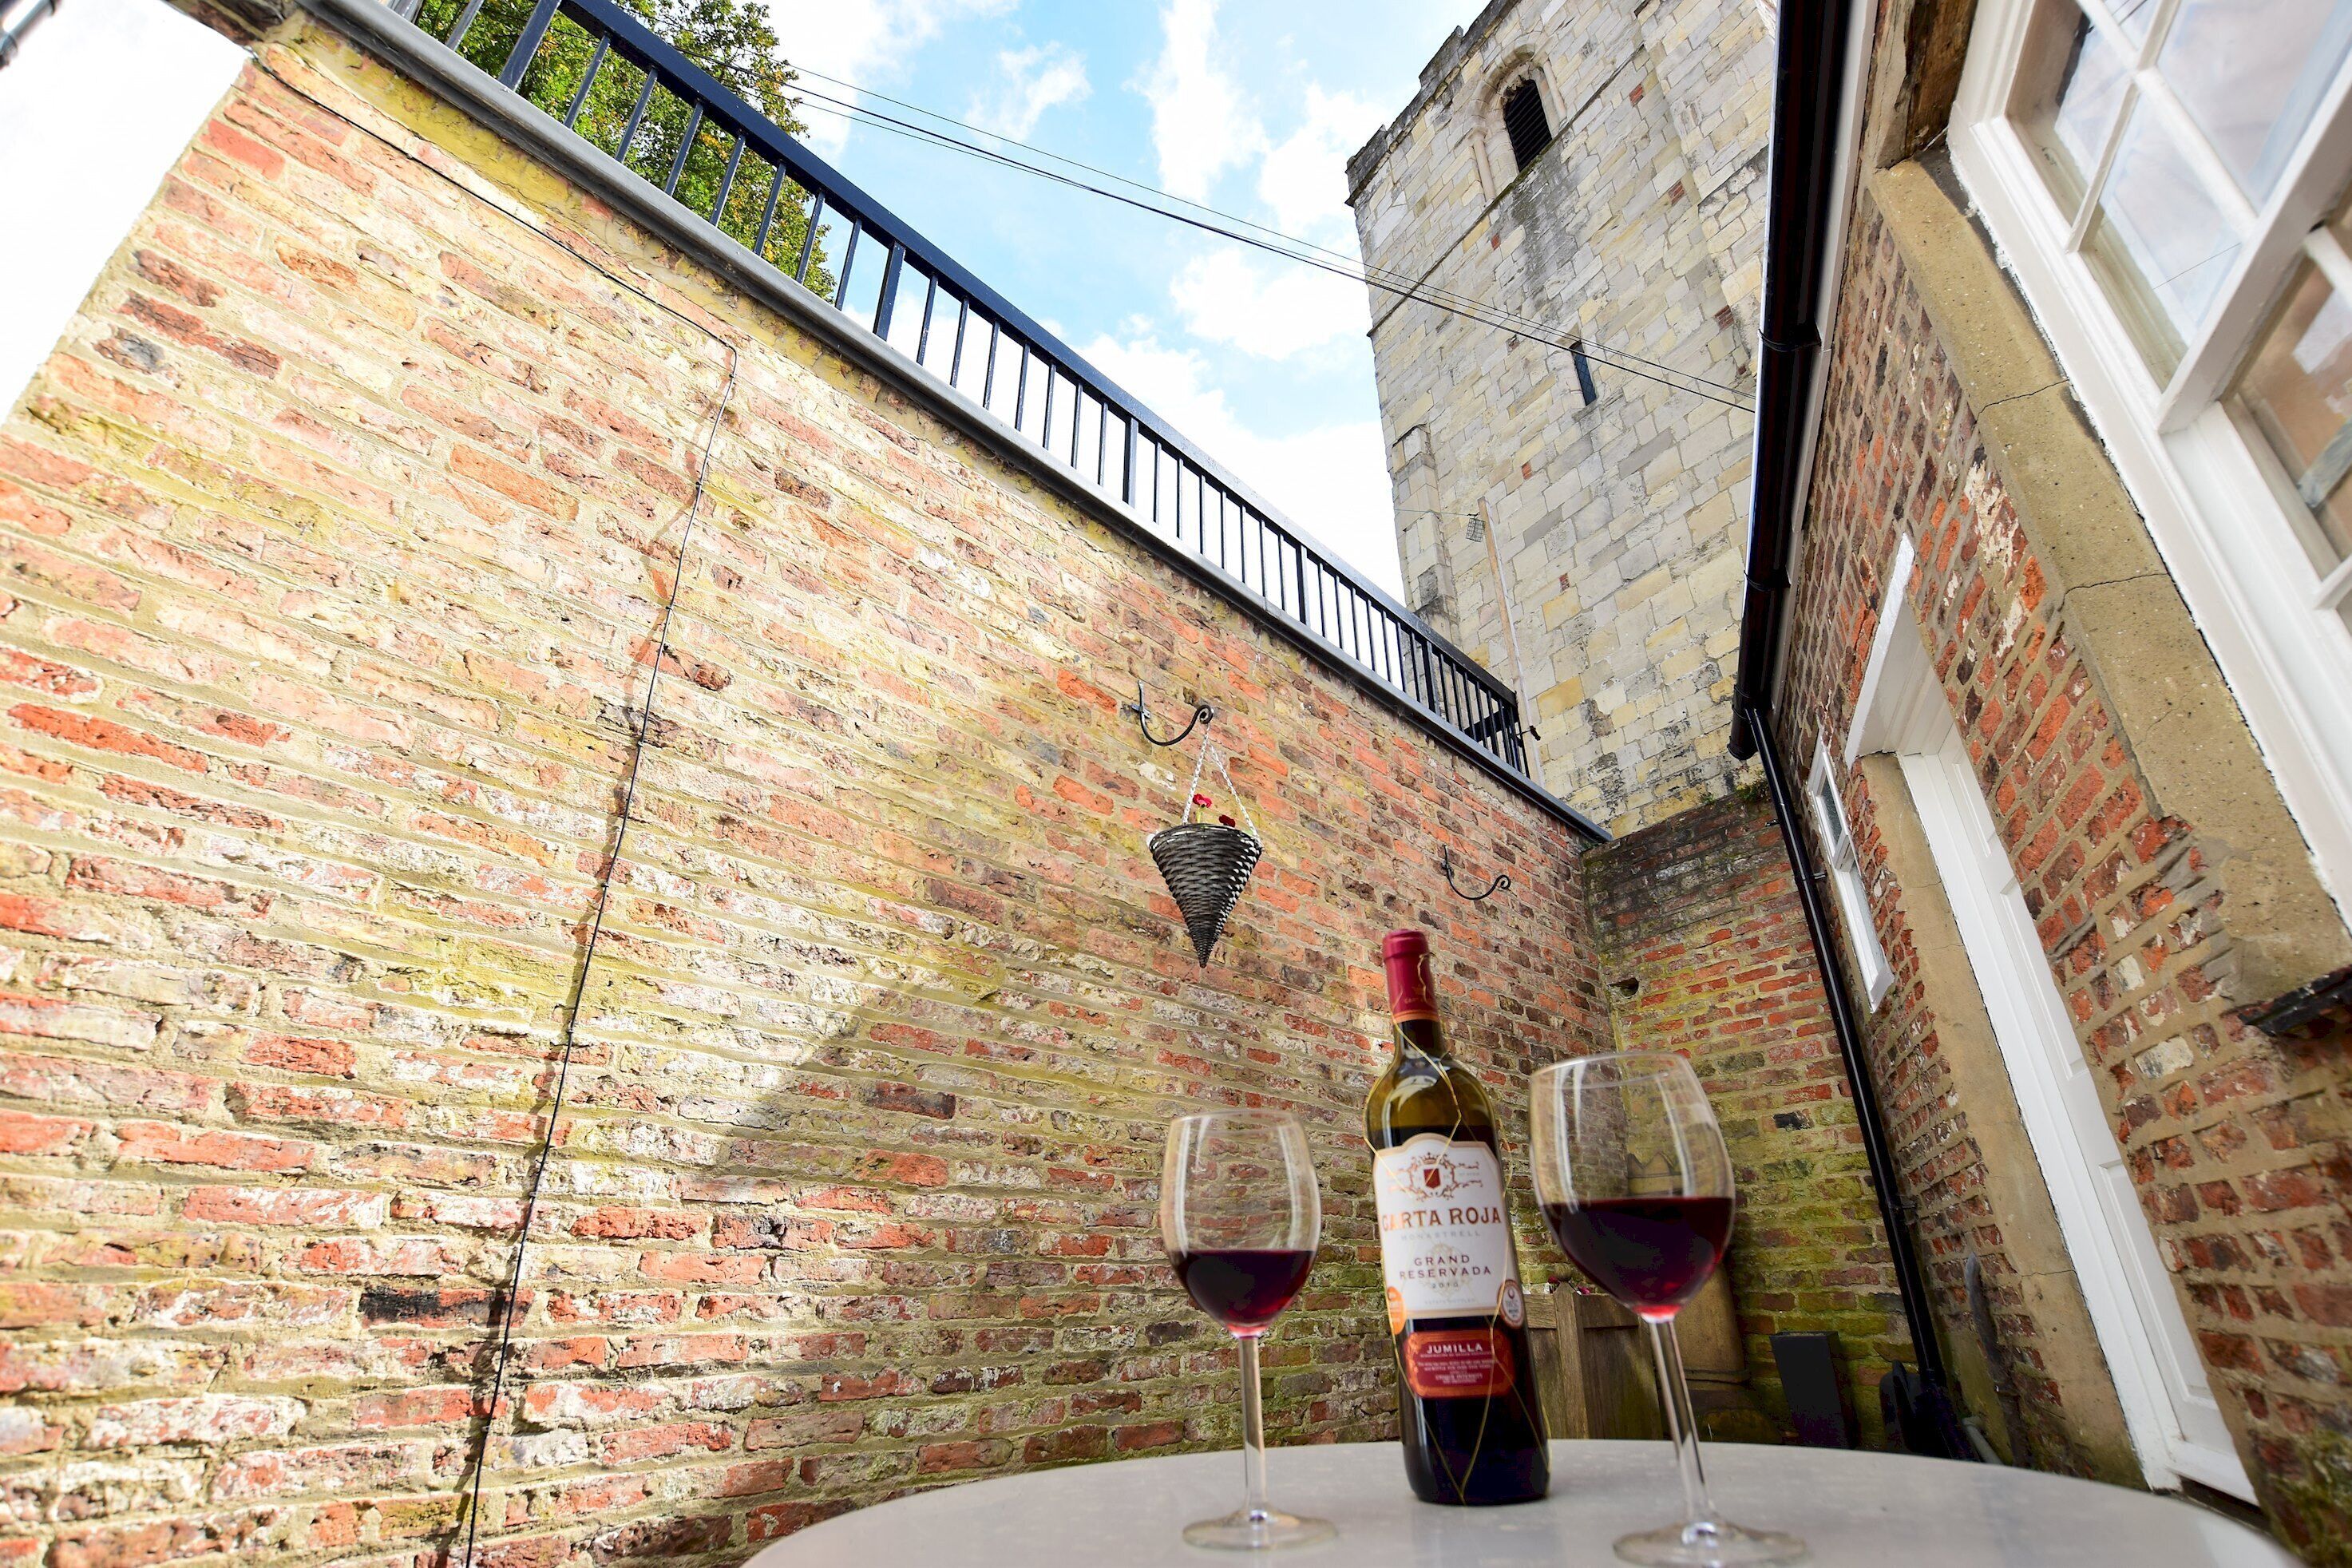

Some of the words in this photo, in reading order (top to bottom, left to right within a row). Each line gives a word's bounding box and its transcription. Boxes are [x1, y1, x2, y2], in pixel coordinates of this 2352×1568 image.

[1382, 1208, 1442, 1231] CARTA
[1448, 1206, 1502, 1225] ROJA
[1414, 1254, 1471, 1266] GRAND
[1400, 1265, 1492, 1281] RESERVADA
[1427, 1343, 1483, 1354] JUMILLA
